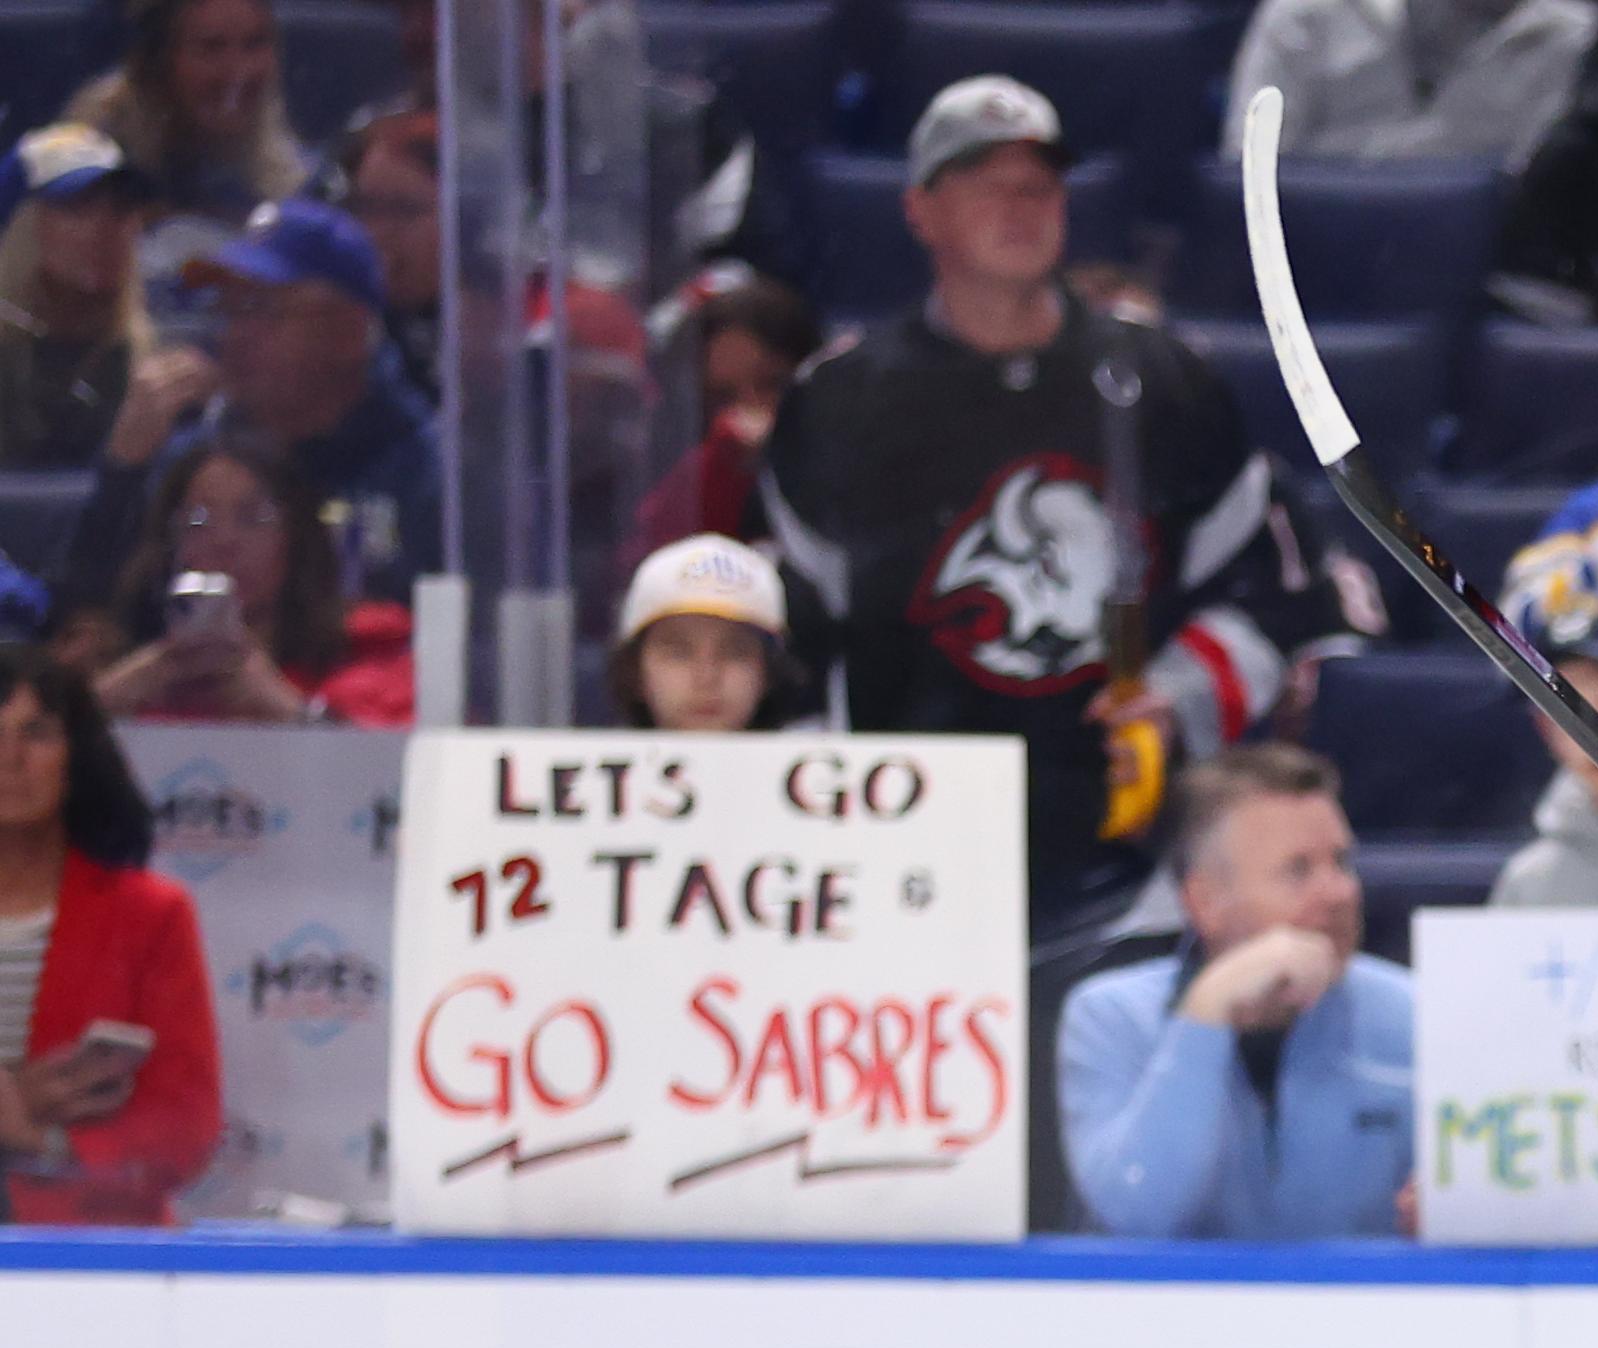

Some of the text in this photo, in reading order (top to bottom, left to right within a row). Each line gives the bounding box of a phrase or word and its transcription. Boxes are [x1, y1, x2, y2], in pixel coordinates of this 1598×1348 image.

[785, 752, 928, 819] GO
[450, 856, 549, 936] 72
[595, 852, 857, 939] TAGE
[415, 973, 1010, 1147] GO SABRES
